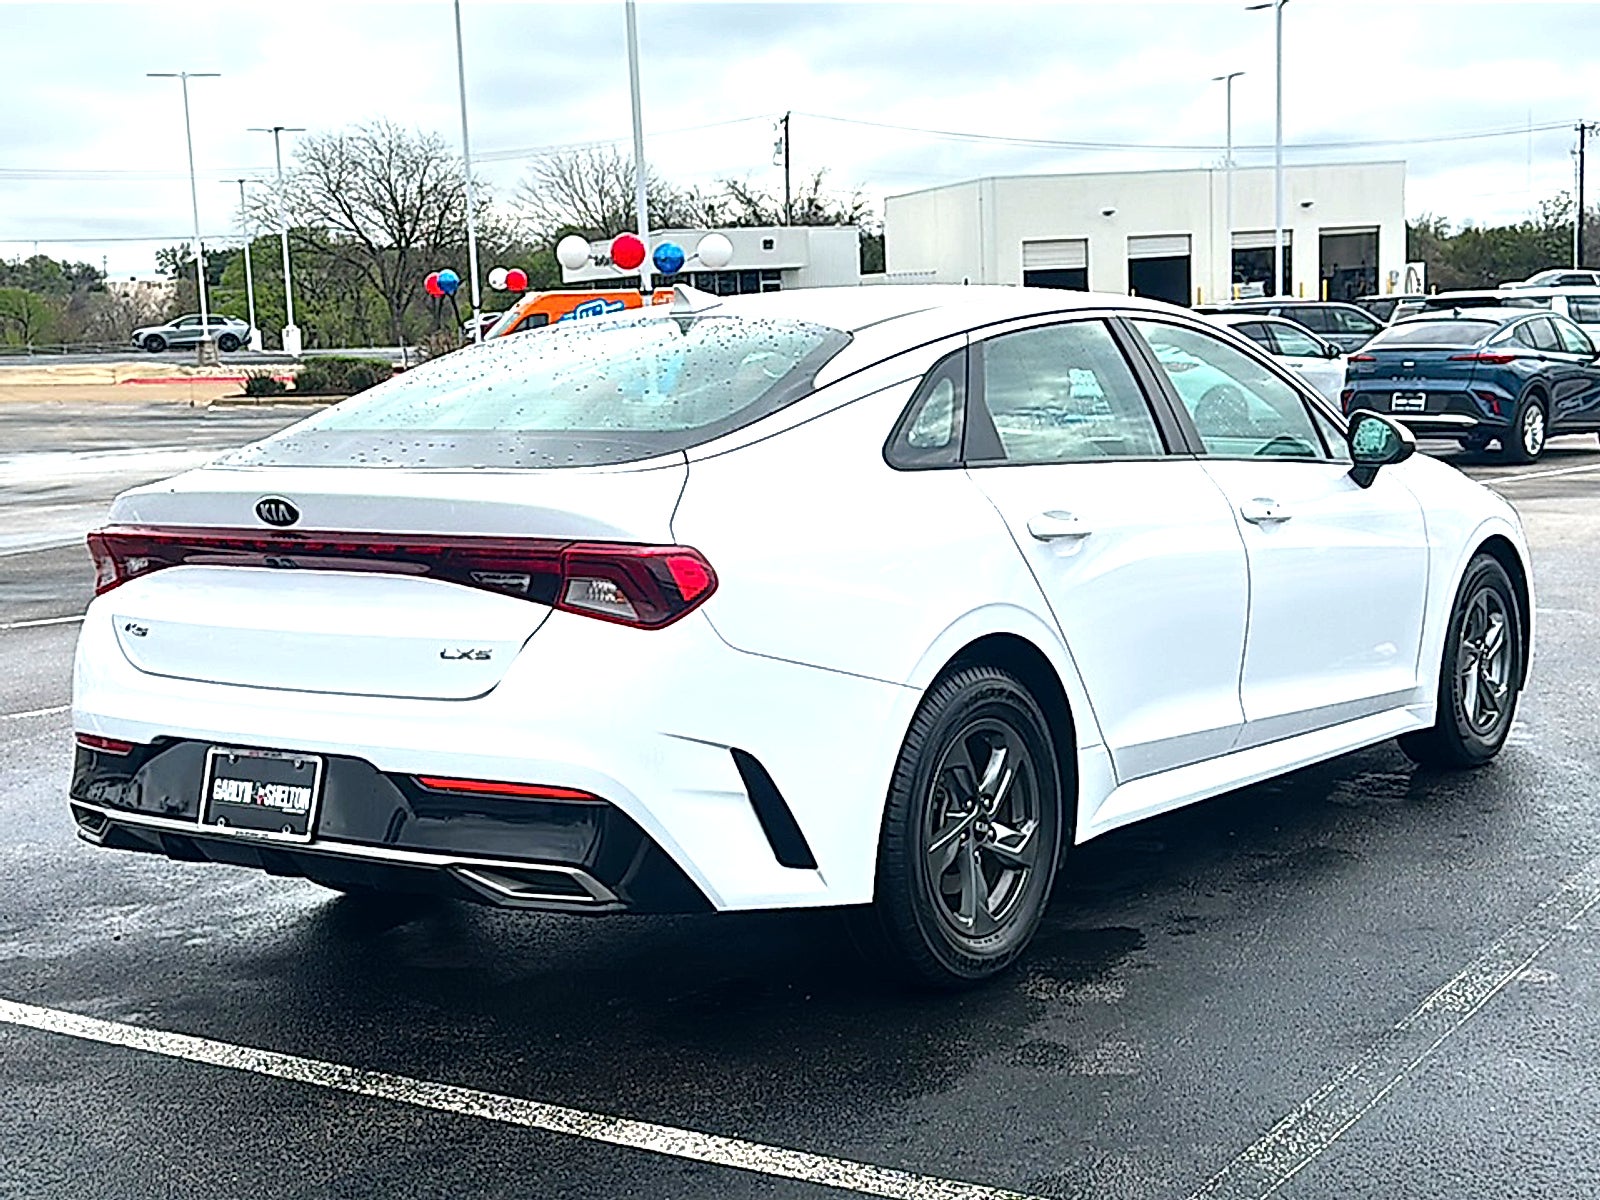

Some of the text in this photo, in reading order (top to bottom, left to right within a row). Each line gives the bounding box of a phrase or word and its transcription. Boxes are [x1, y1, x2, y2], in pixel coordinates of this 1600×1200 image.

[259, 503, 292, 521] KIA
[440, 647, 493, 661] LXS
[264, 783, 312, 810] SHELTON
